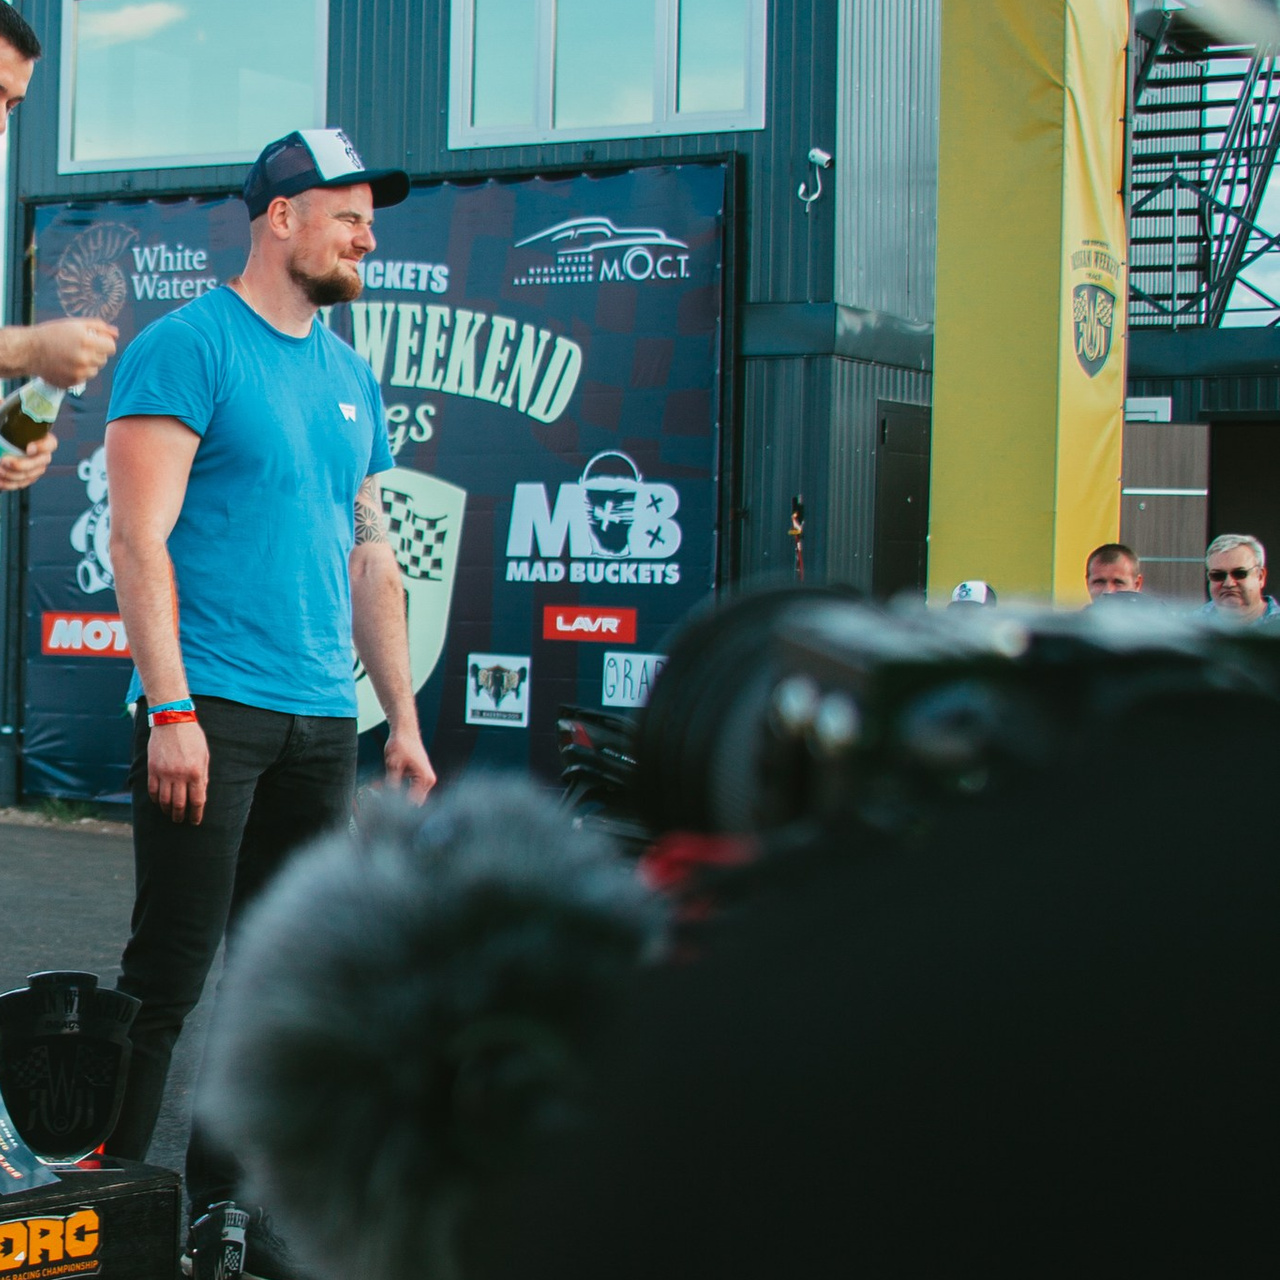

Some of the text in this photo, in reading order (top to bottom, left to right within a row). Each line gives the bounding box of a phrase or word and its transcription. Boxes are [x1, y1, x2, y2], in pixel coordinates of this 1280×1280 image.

[132, 244, 207, 272] White
[131, 274, 217, 300] Waters
[360, 260, 449, 294] CKETS
[350, 302, 582, 423] WEEKEND
[505, 561, 681, 585] MAD BUCKETS
[48, 618, 128, 651] MOT
[556, 615, 619, 633] LAVR
[41, 1260, 99, 1277] CHAMPIONSHIP
